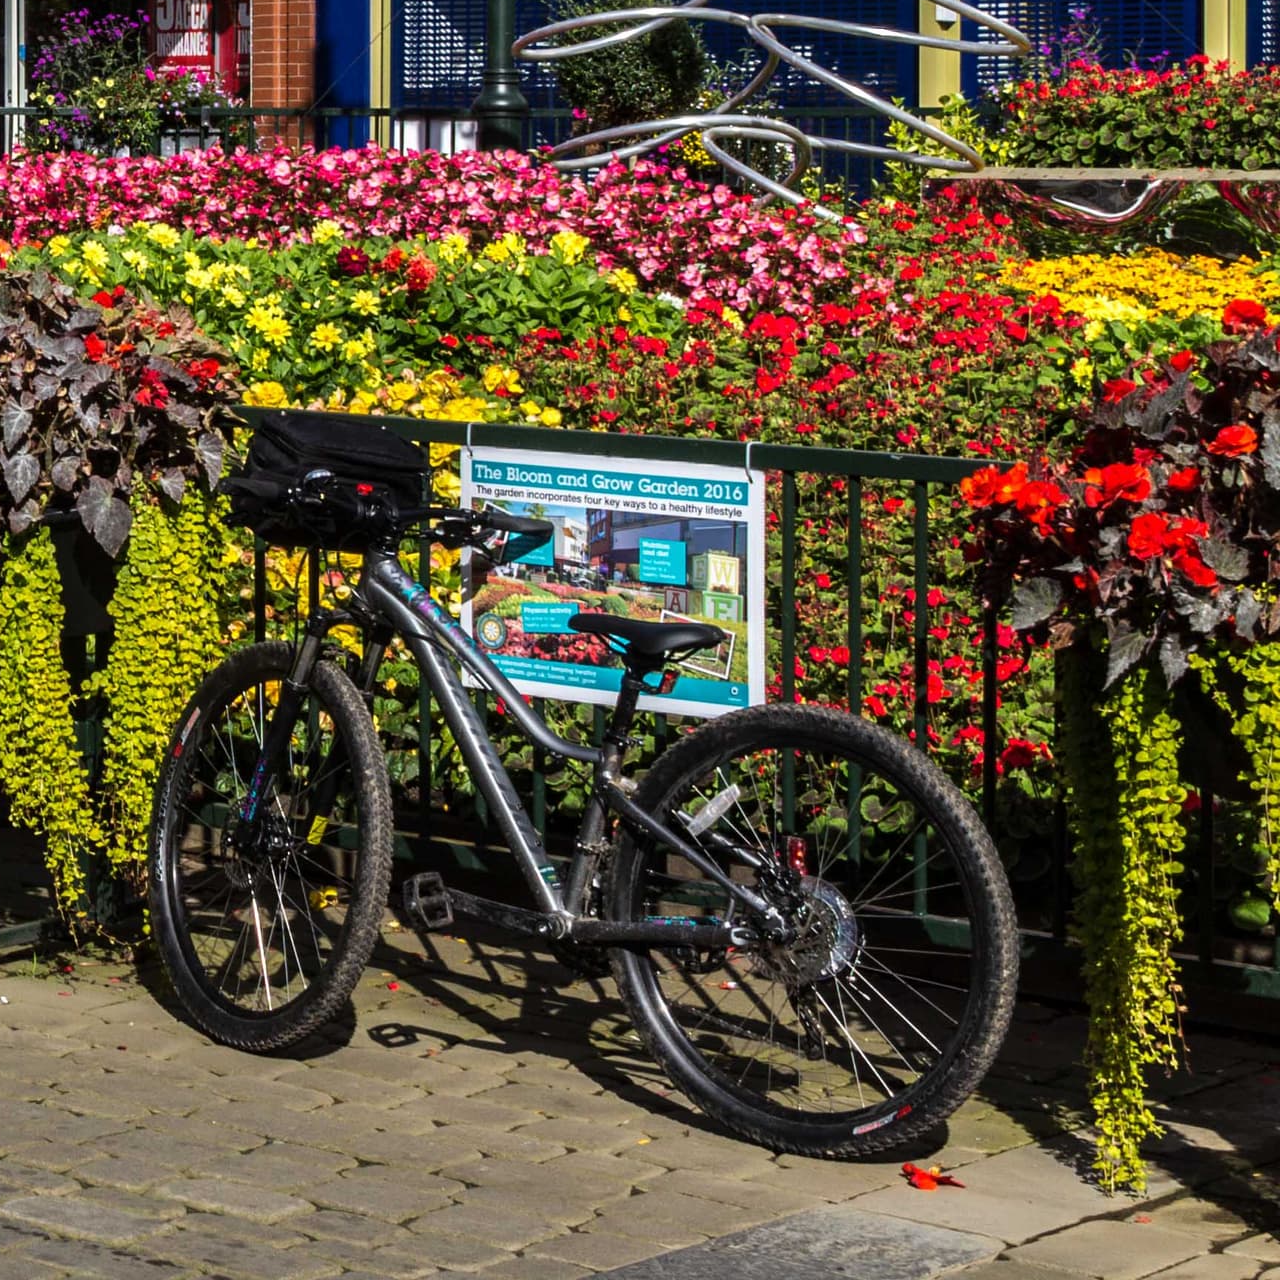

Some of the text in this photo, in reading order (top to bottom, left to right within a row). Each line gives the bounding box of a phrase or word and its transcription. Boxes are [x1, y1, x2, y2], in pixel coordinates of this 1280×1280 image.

[157, 32, 208, 57] INSURANCE
[475, 464, 744, 501] The Bloom and Grow Garden 2016
[476, 485, 492, 495] The
[494, 487, 524, 498] garden
[527, 489, 582, 504] incorporates
[584, 495, 602, 505] four
[604, 497, 620, 507] key
[623, 500, 646, 510] ways
[648, 501, 658, 510] to
[669, 502, 703, 515] healthy
[705, 506, 743, 518] lifestyle
[712, 559, 735, 584] W
[670, 592, 681, 613] A
